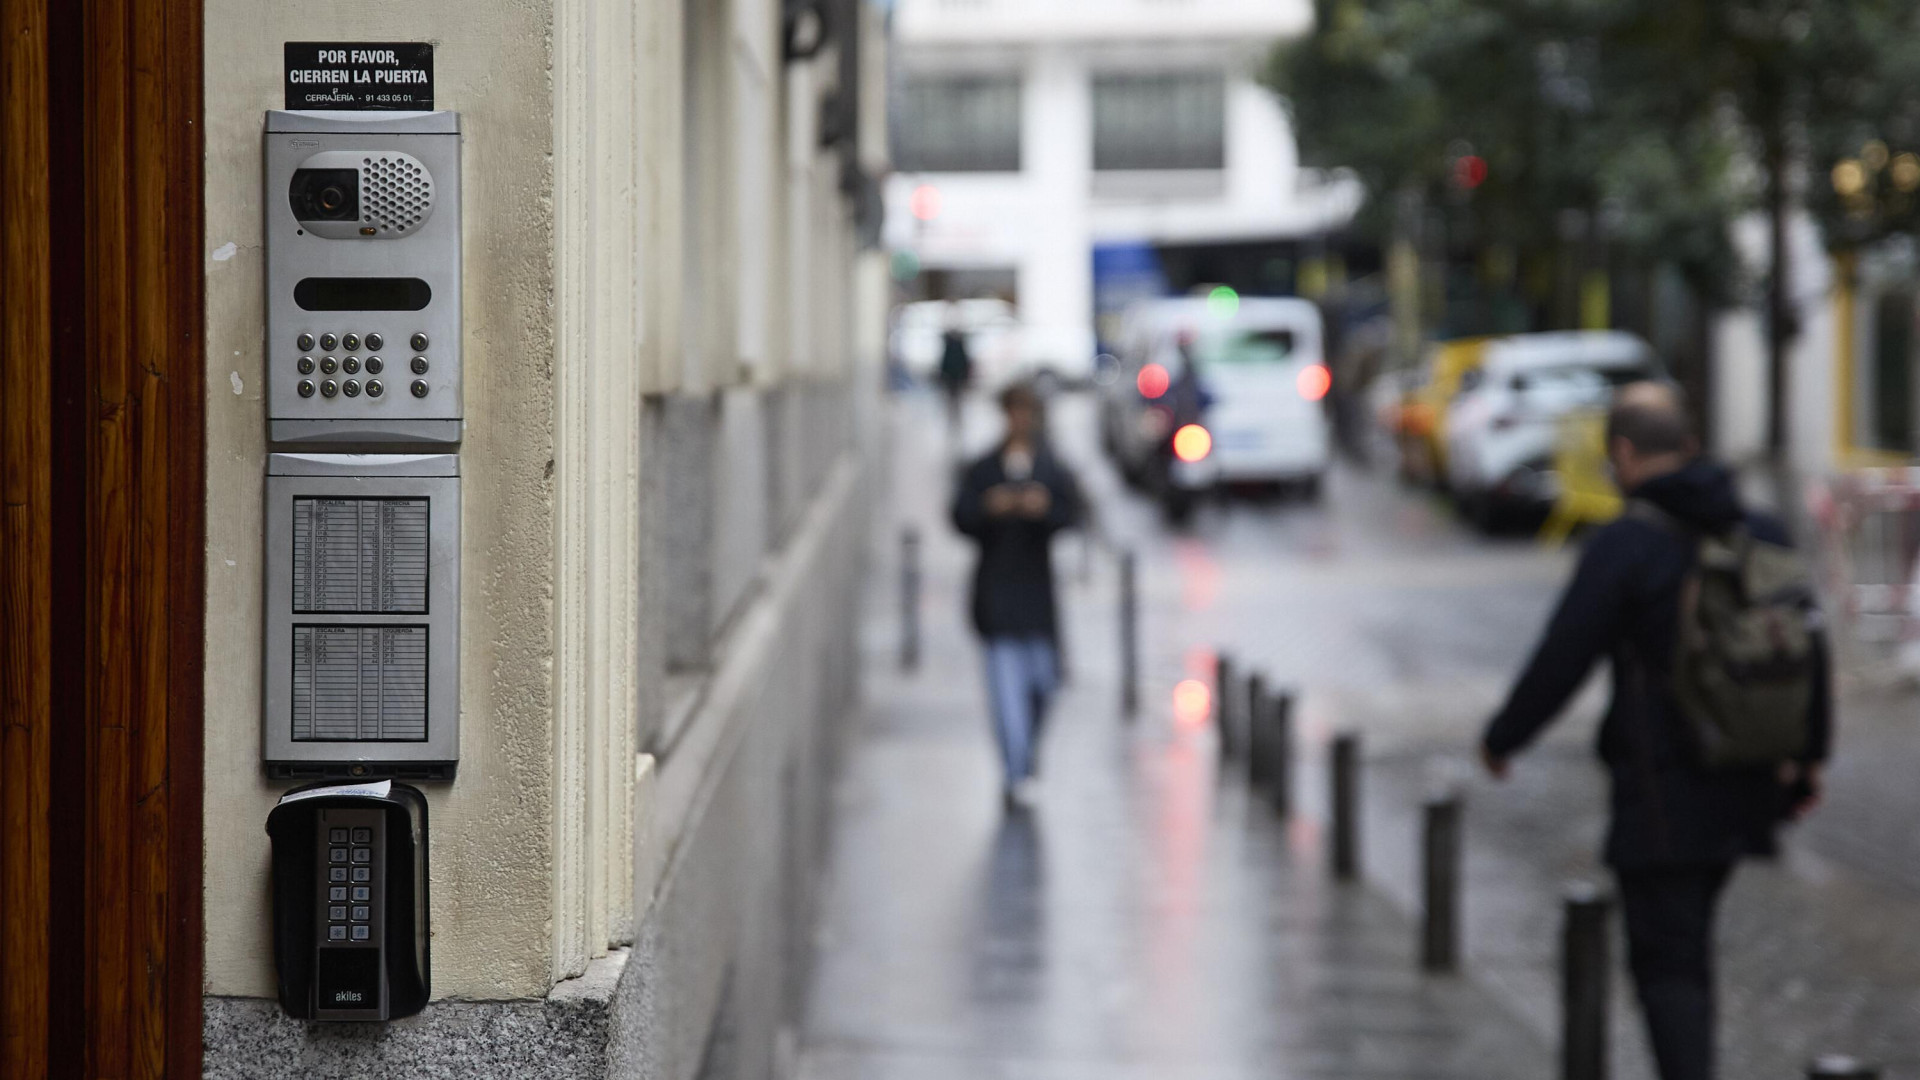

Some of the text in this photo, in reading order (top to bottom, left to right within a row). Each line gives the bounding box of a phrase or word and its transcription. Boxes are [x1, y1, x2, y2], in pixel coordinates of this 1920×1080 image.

[318, 50, 399, 66] POR FAVOR,
[290, 70, 428, 83] CIERREN LA PUERTA
[305, 93, 354, 102] CERRAJERÍA
[336, 832, 365, 840] 1 2
[335, 850, 364, 859] 3 4
[336, 870, 364, 878] 5 6
[336, 889, 364, 898] 7 8
[357, 909, 363, 917] 0
[336, 990, 362, 1001] akiles
